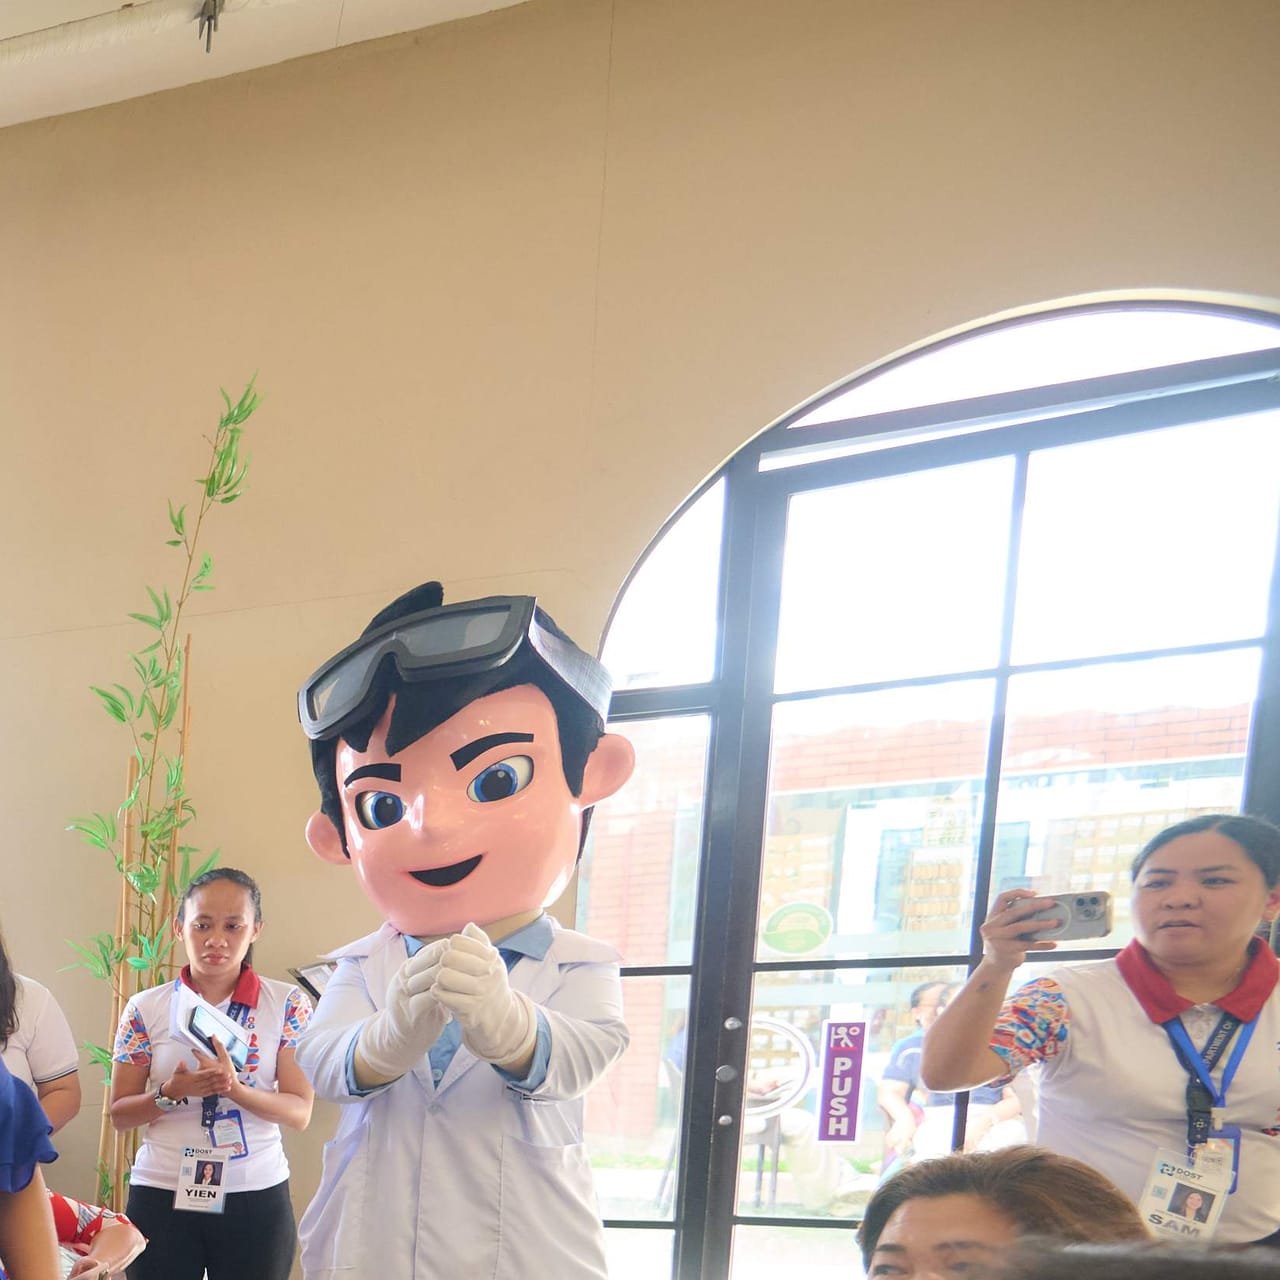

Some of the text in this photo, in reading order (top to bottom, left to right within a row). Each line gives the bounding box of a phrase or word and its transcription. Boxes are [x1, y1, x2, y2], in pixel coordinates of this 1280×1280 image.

[827, 1057, 853, 1136] PUSH
[1176, 1167, 1204, 1180] DOST
[184, 1189, 217, 1199] YIEN
[1148, 1213, 1201, 1238] SAM
